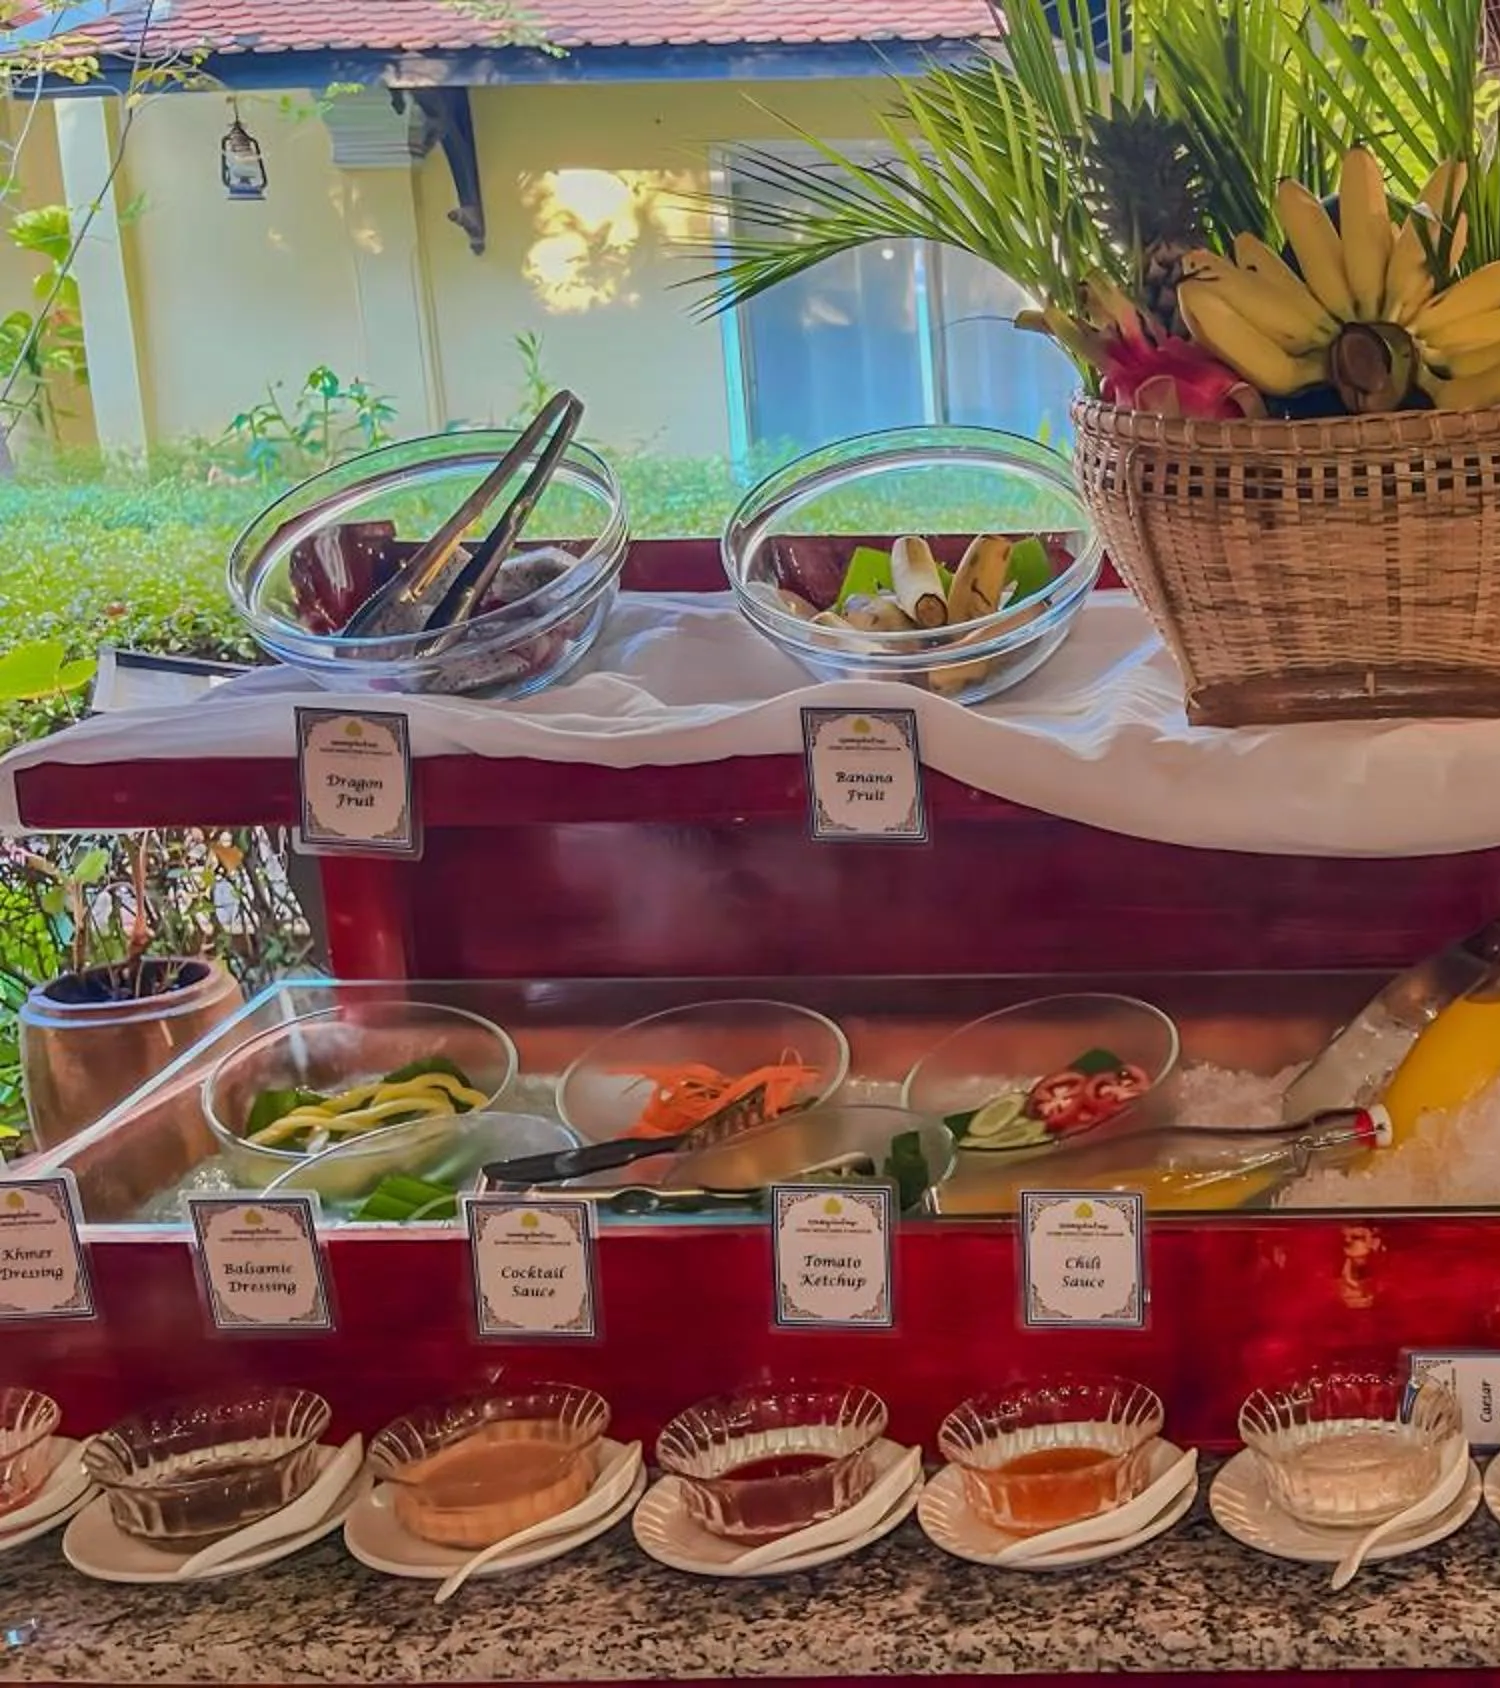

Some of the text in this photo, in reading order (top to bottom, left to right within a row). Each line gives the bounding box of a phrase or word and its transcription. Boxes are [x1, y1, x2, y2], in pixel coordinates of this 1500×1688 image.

[325, 773, 384, 793] Dragon
[834, 770, 894, 784] Banana
[335, 793, 375, 809] Fruit
[845, 788, 885, 805] Fruit
[1, 1248, 54, 1261] Khmer
[802, 1254, 863, 1269] Tomato
[222, 1260, 294, 1275] Balsamic
[1063, 1255, 1102, 1270] Chili
[0, 1266, 64, 1281] Dressing
[500, 1264, 568, 1280] Cocktail
[227, 1280, 298, 1296] Dressing
[799, 1272, 867, 1291] Ketchup
[1061, 1274, 1105, 1289] Sauce
[511, 1284, 556, 1298] Sauce
[1479, 1377, 1493, 1424] Caesar
